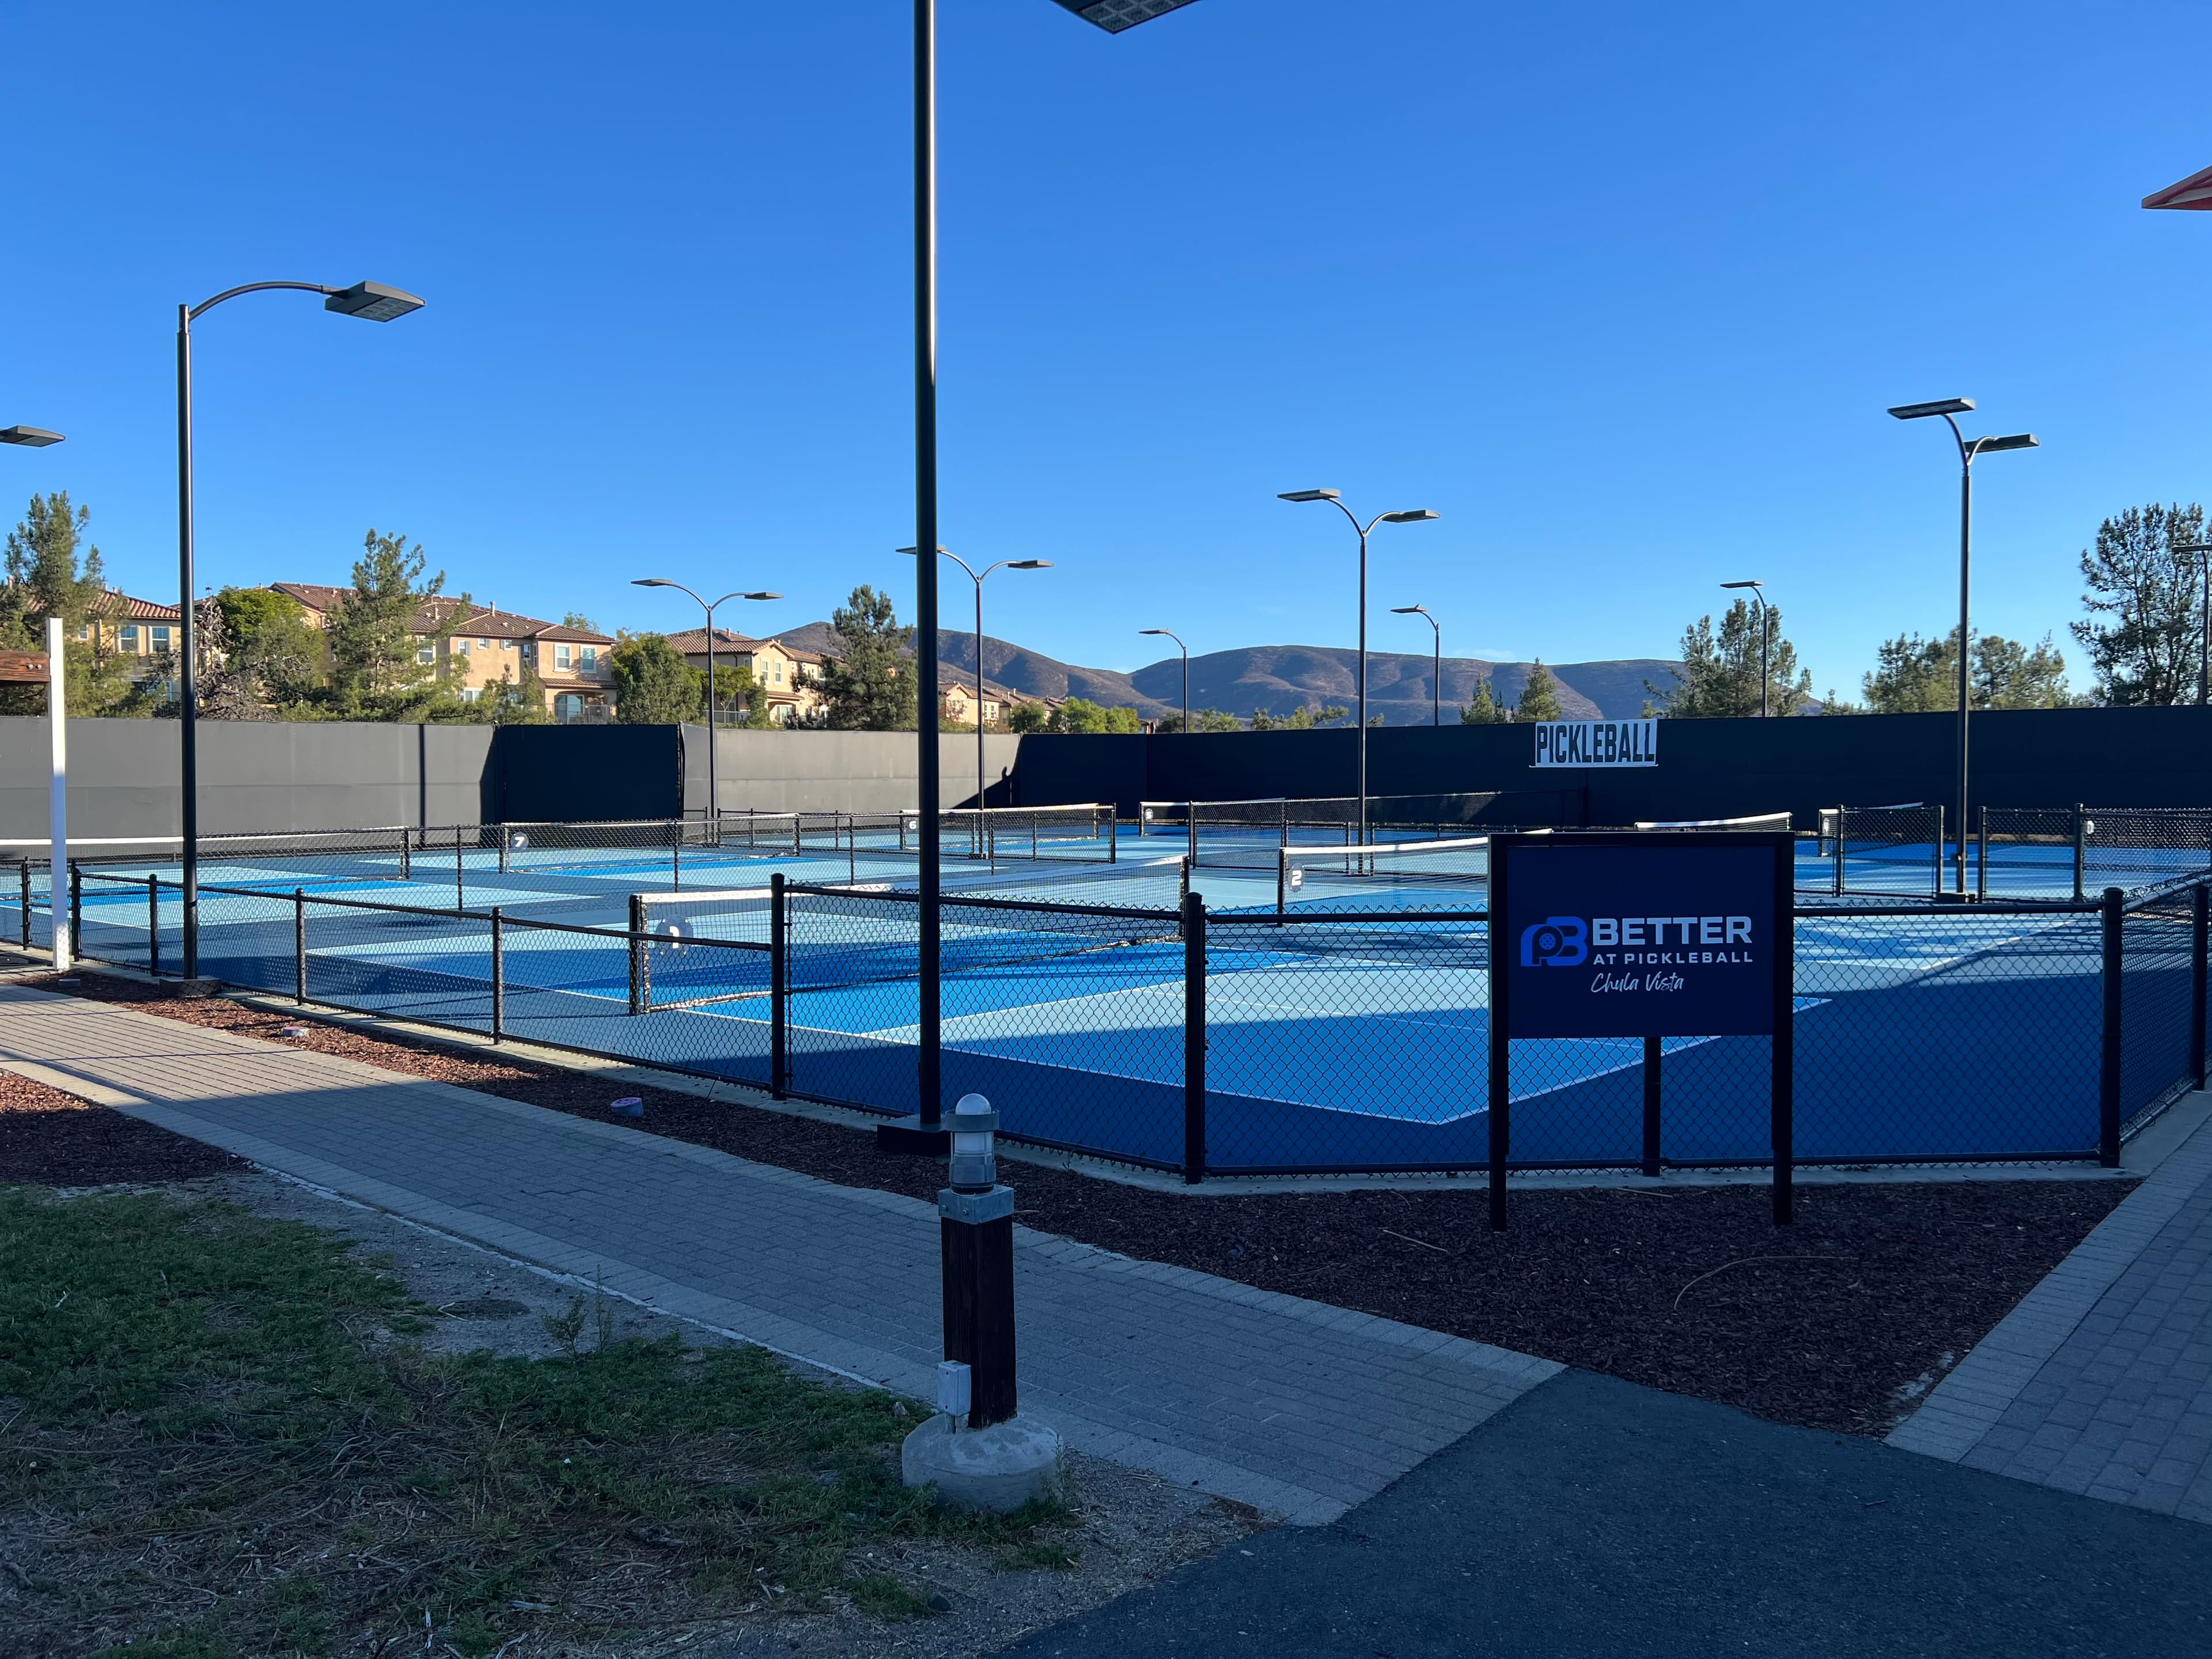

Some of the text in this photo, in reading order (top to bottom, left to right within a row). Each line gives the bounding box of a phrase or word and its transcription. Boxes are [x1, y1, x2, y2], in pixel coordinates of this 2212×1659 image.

[1536, 723, 1655, 763] PICKLEBALL
[909, 820, 916, 830] 6
[514, 836, 525, 847] 7
[1291, 870, 1302, 886] 2
[1592, 916, 1753, 946] BETTER
[1593, 951, 1753, 965] AT PICKLEBALL
[1590, 971, 1684, 993] Chula Vista
